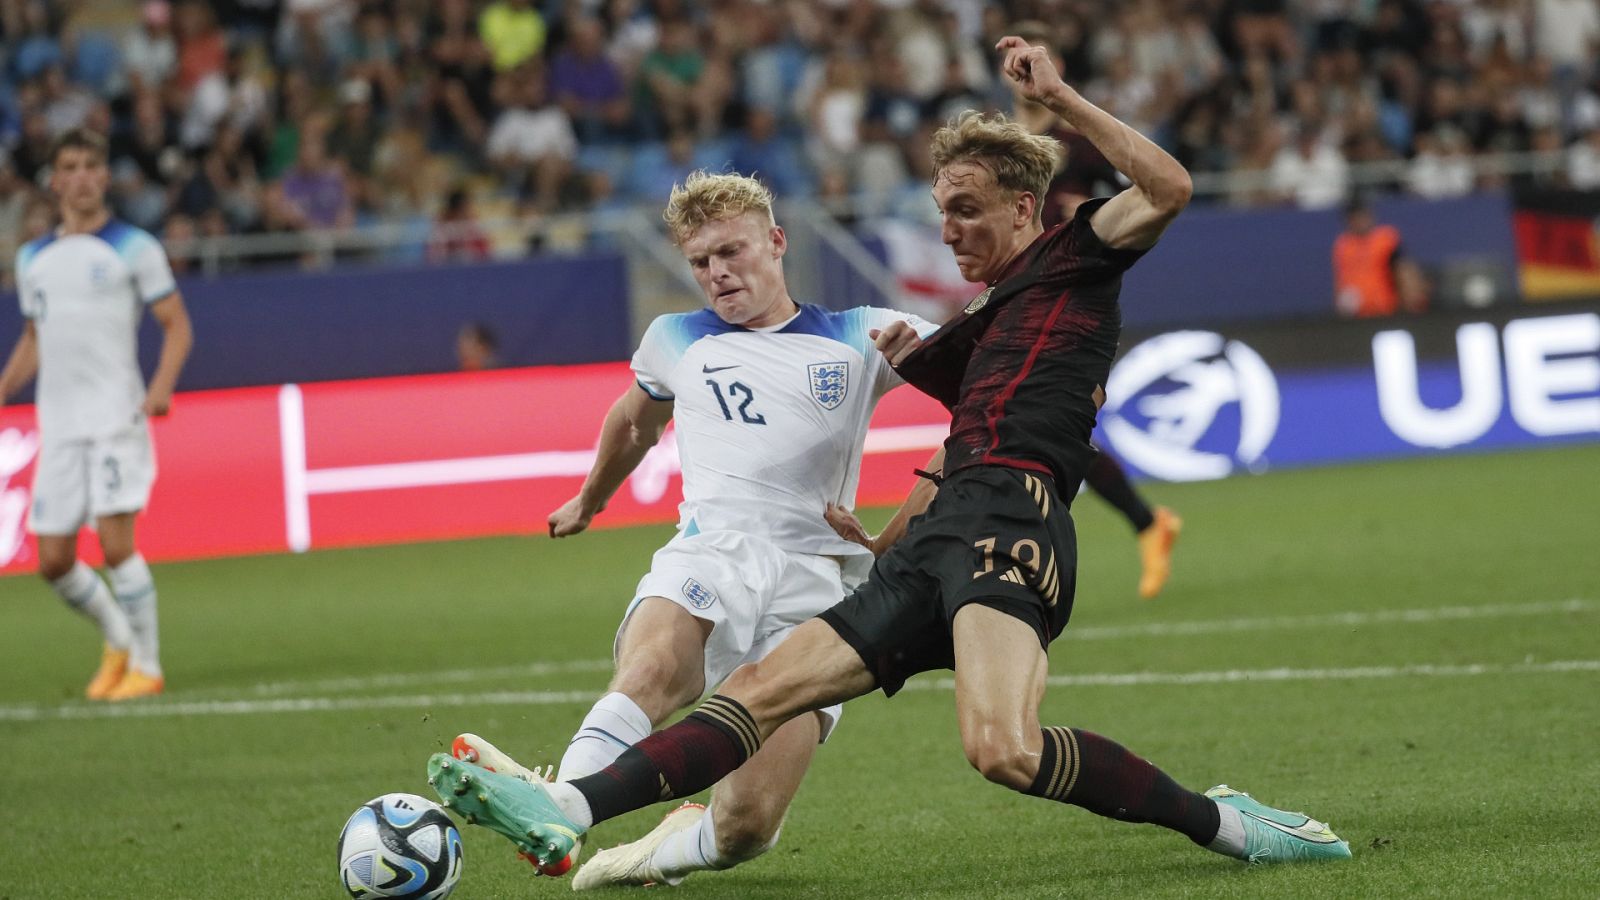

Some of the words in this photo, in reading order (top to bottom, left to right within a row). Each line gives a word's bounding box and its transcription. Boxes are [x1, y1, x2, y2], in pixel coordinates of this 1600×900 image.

[705, 379, 767, 426] 12
[103, 455, 122, 491] 3
[973, 537, 1041, 579] 19
